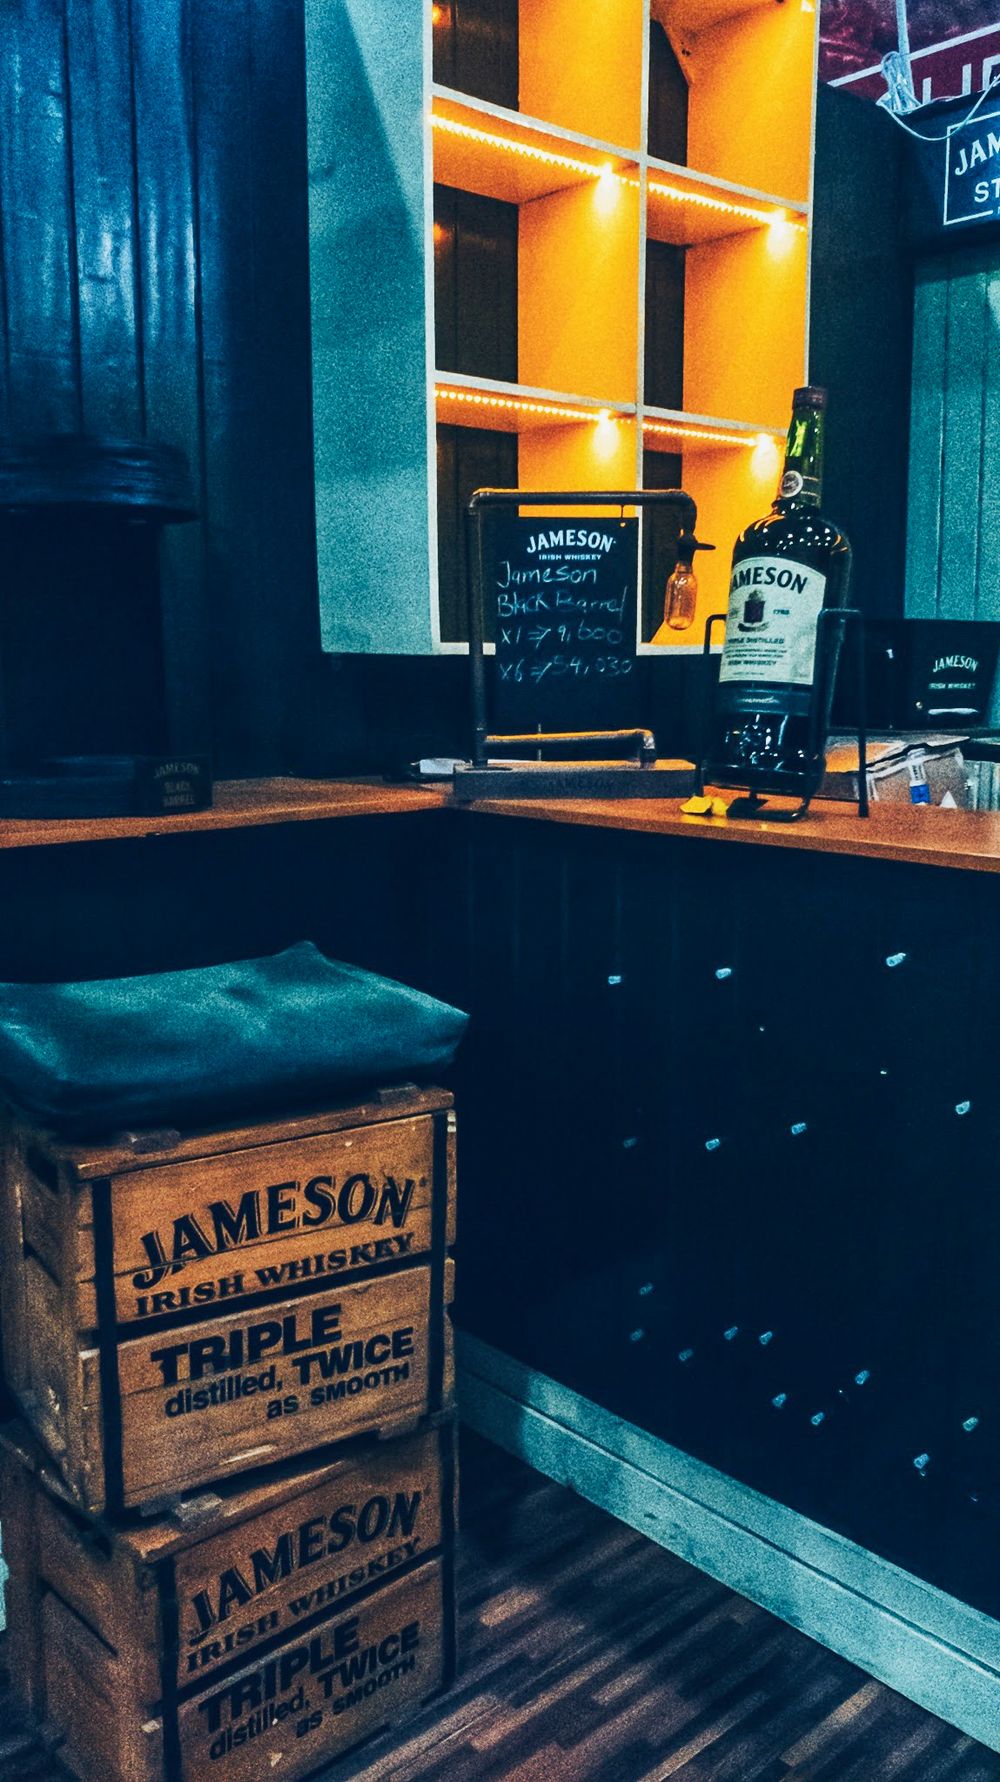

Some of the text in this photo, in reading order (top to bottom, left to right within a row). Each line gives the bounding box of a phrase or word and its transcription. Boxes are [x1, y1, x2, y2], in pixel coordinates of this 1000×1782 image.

[497, 561, 597, 588] Jameson
[527, 529, 613, 554] JAMESON
[933, 655, 979, 672] JAMESON
[153, 762, 200, 779] JAMESON
[132, 1173, 415, 1290] JAMESON
[137, 1232, 415, 1316] IRISH WHISKEY
[151, 1303, 342, 1386] TRIPLE
[292, 1326, 414, 1386] TWICE
[266, 1362, 410, 1419] as SMOOTH
[190, 1491, 421, 1647] JAMESON
[186, 1536, 421, 1674] IRISH WHISKEY
[198, 1616, 360, 1734] TRIPLE
[315, 1620, 420, 1699] TWICE
[333, 1654, 416, 1714] SMOOTH
